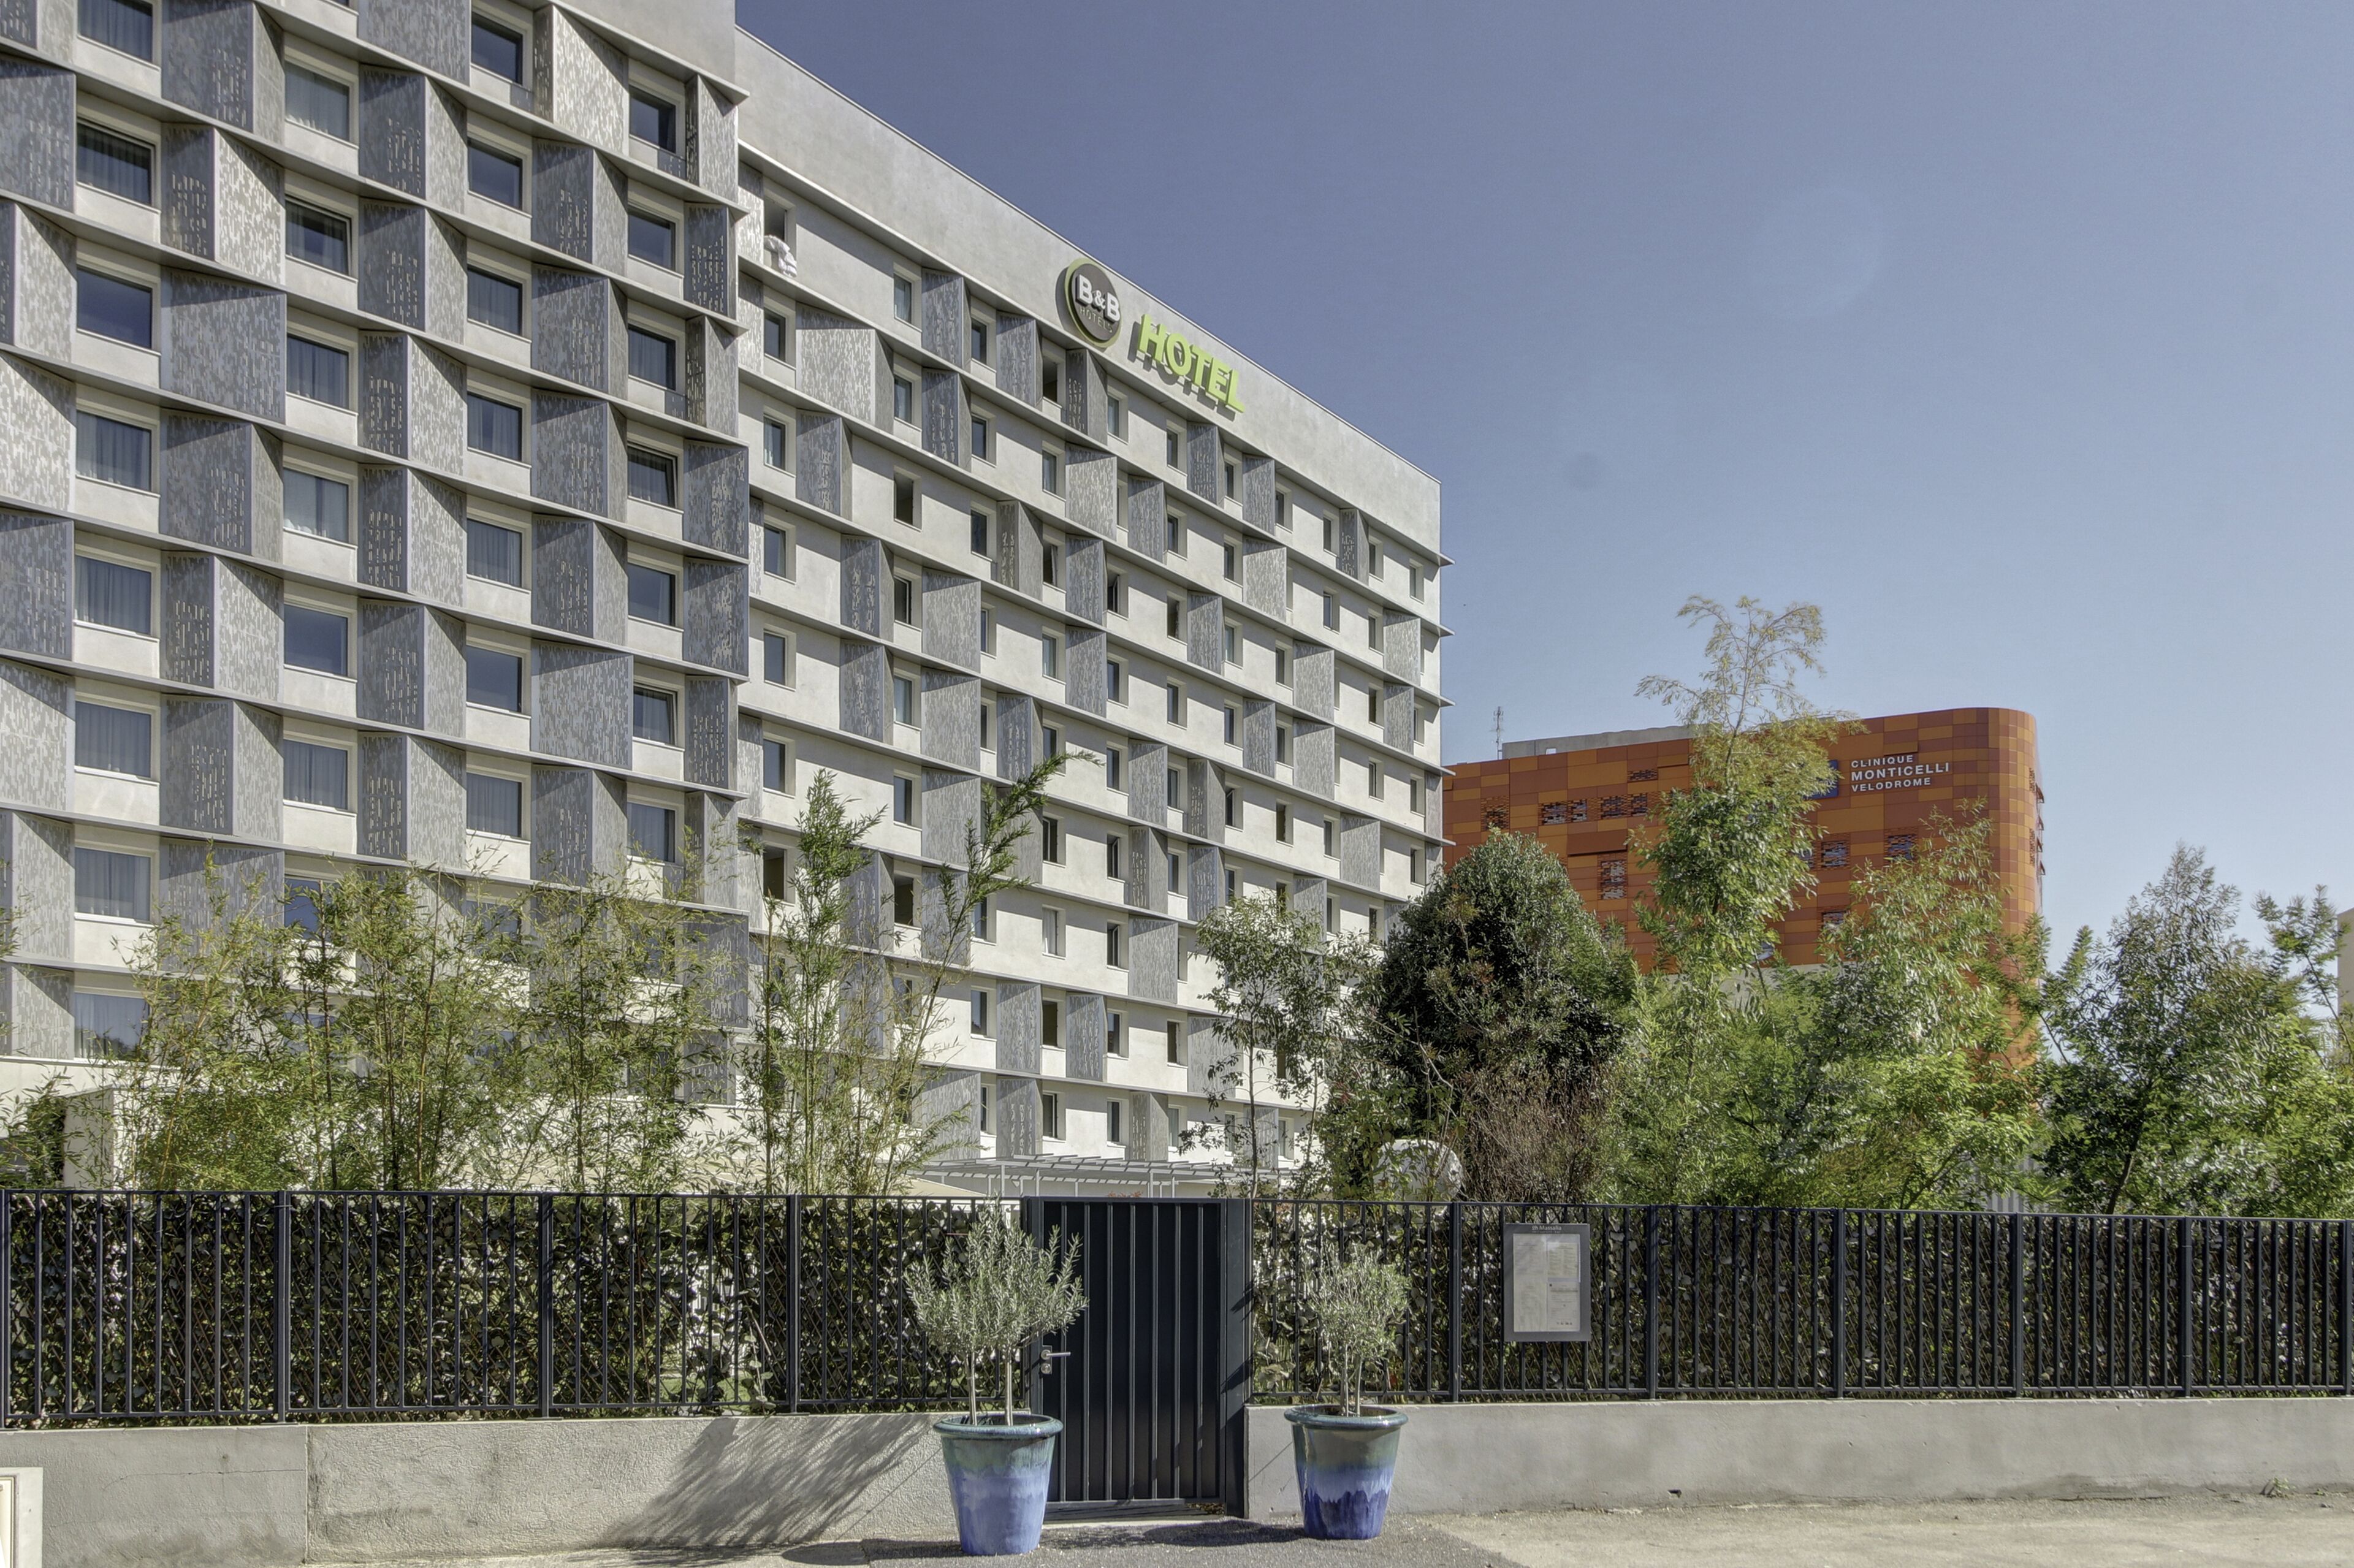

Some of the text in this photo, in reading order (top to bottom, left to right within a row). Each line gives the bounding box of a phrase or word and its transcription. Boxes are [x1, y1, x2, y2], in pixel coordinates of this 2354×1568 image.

[1078, 274, 1120, 321] B&B
[1138, 313, 1245, 413] HOTEL
[1851, 755, 1913, 768] CLINIQUE
[1851, 763, 1949, 781] MONTICELLI
[1851, 777, 1931, 792] VELODROME
